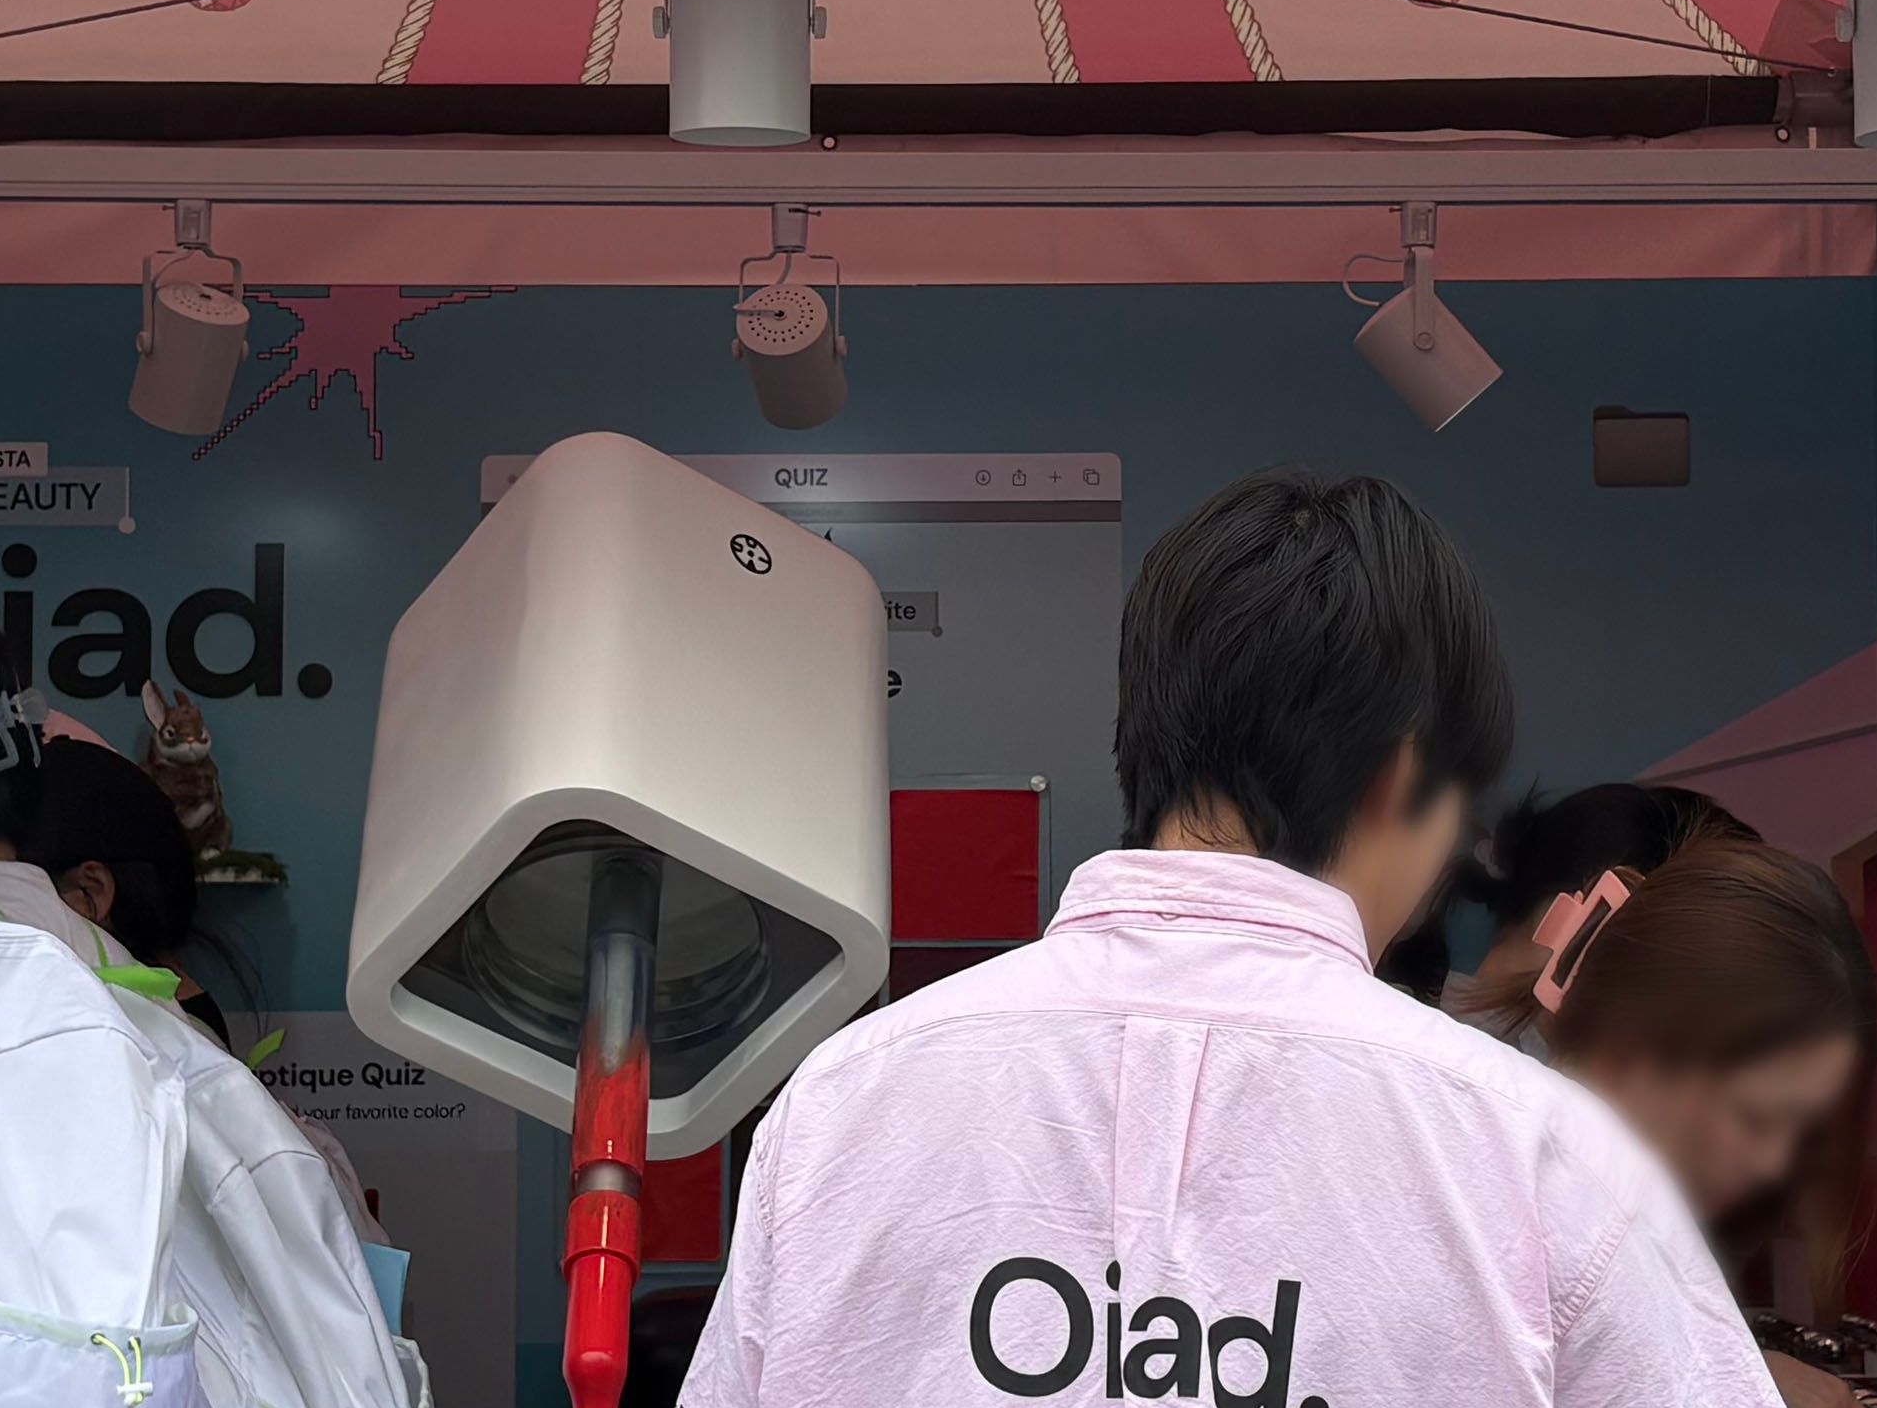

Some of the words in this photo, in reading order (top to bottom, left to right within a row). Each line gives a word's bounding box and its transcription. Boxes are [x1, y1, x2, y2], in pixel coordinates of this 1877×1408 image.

[774, 469, 828, 487] QUIZ
[2, 543, 334, 699] iad.
[885, 601, 917, 621] ite
[255, 1063, 354, 1093] ptique
[362, 1062, 426, 1089] Quiz
[346, 1104, 409, 1120] favorite
[414, 1103, 466, 1119] color?
